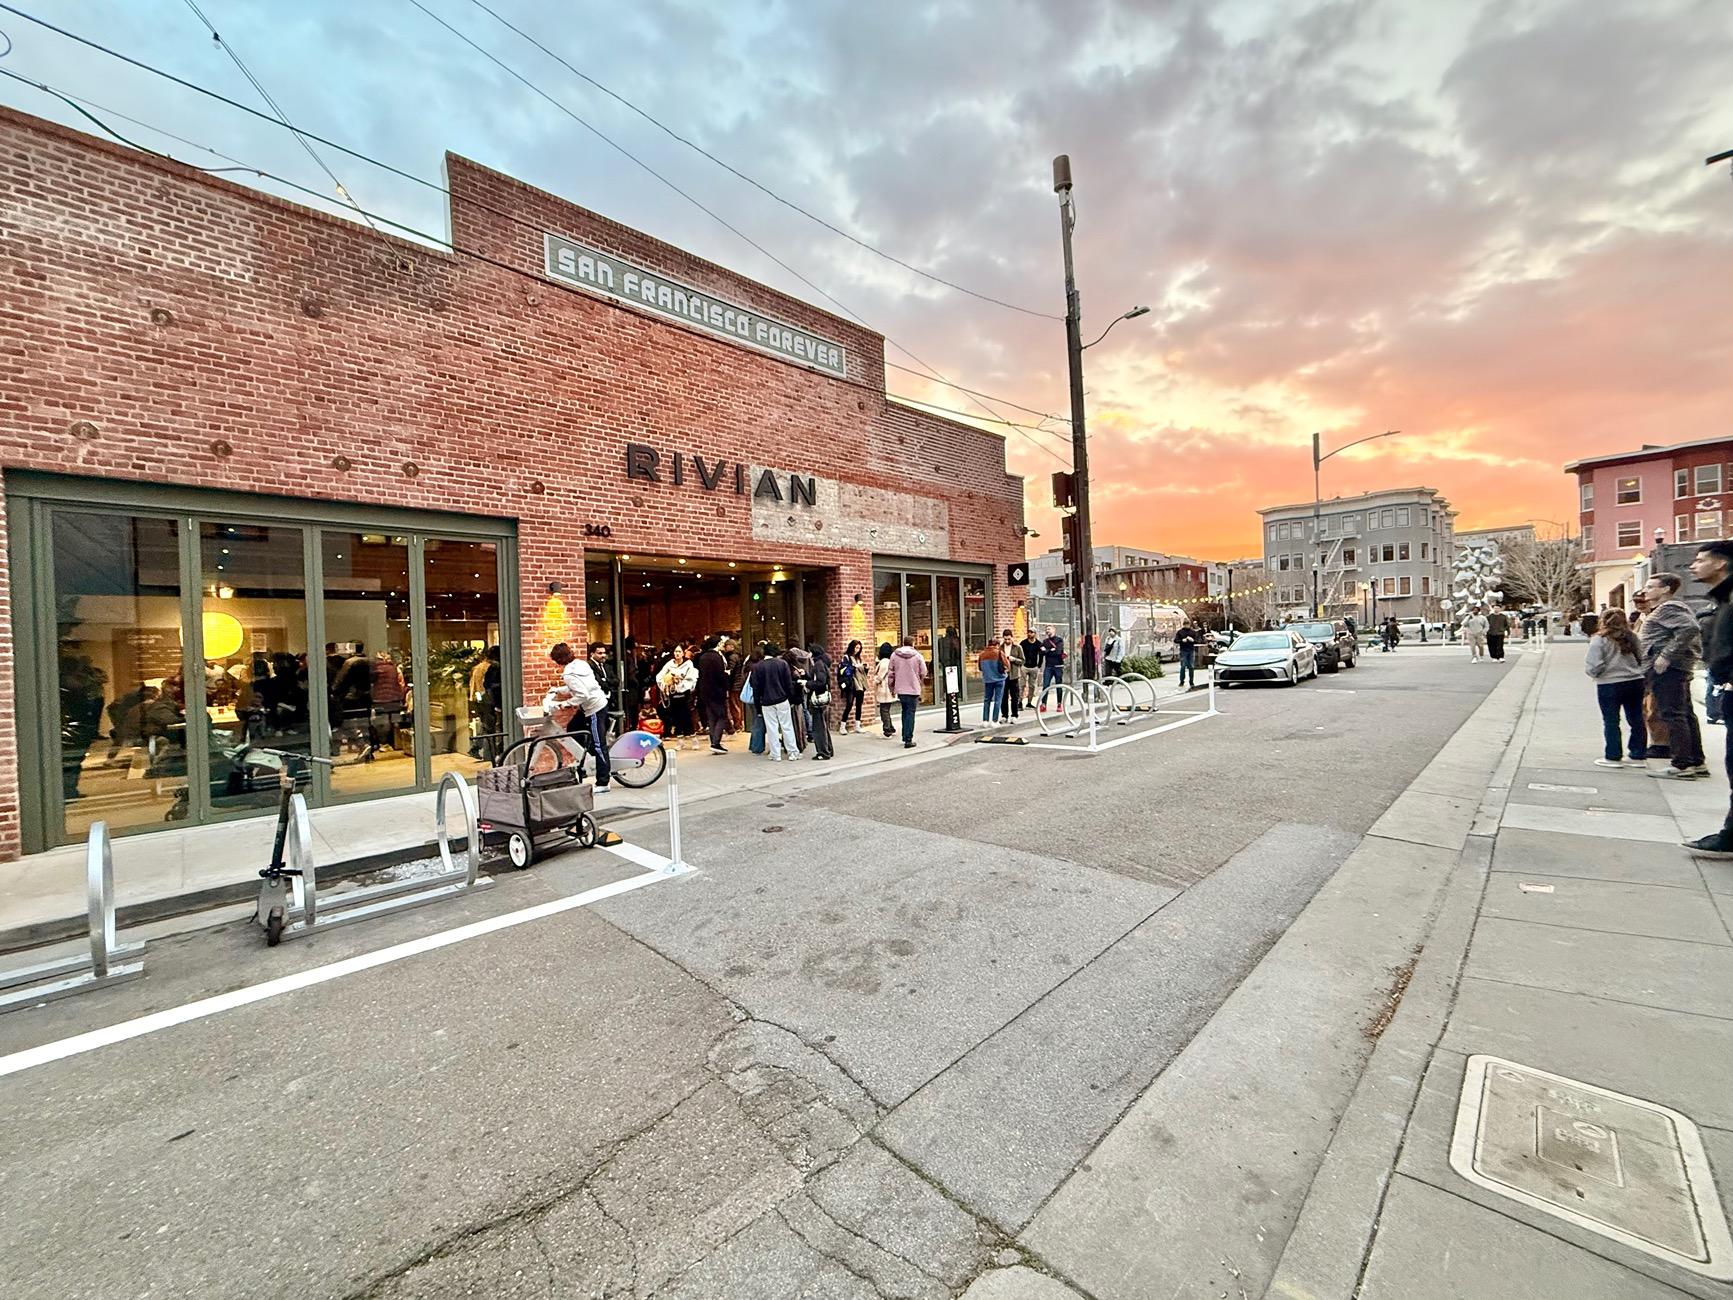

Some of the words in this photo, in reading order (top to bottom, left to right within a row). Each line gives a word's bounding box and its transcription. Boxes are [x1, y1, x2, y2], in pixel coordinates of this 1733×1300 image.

[558, 247, 613, 287] SAN
[623, 272, 750, 336] FRANCISCO
[756, 322, 839, 367] FOREVER
[627, 443, 816, 506] RIVIAN
